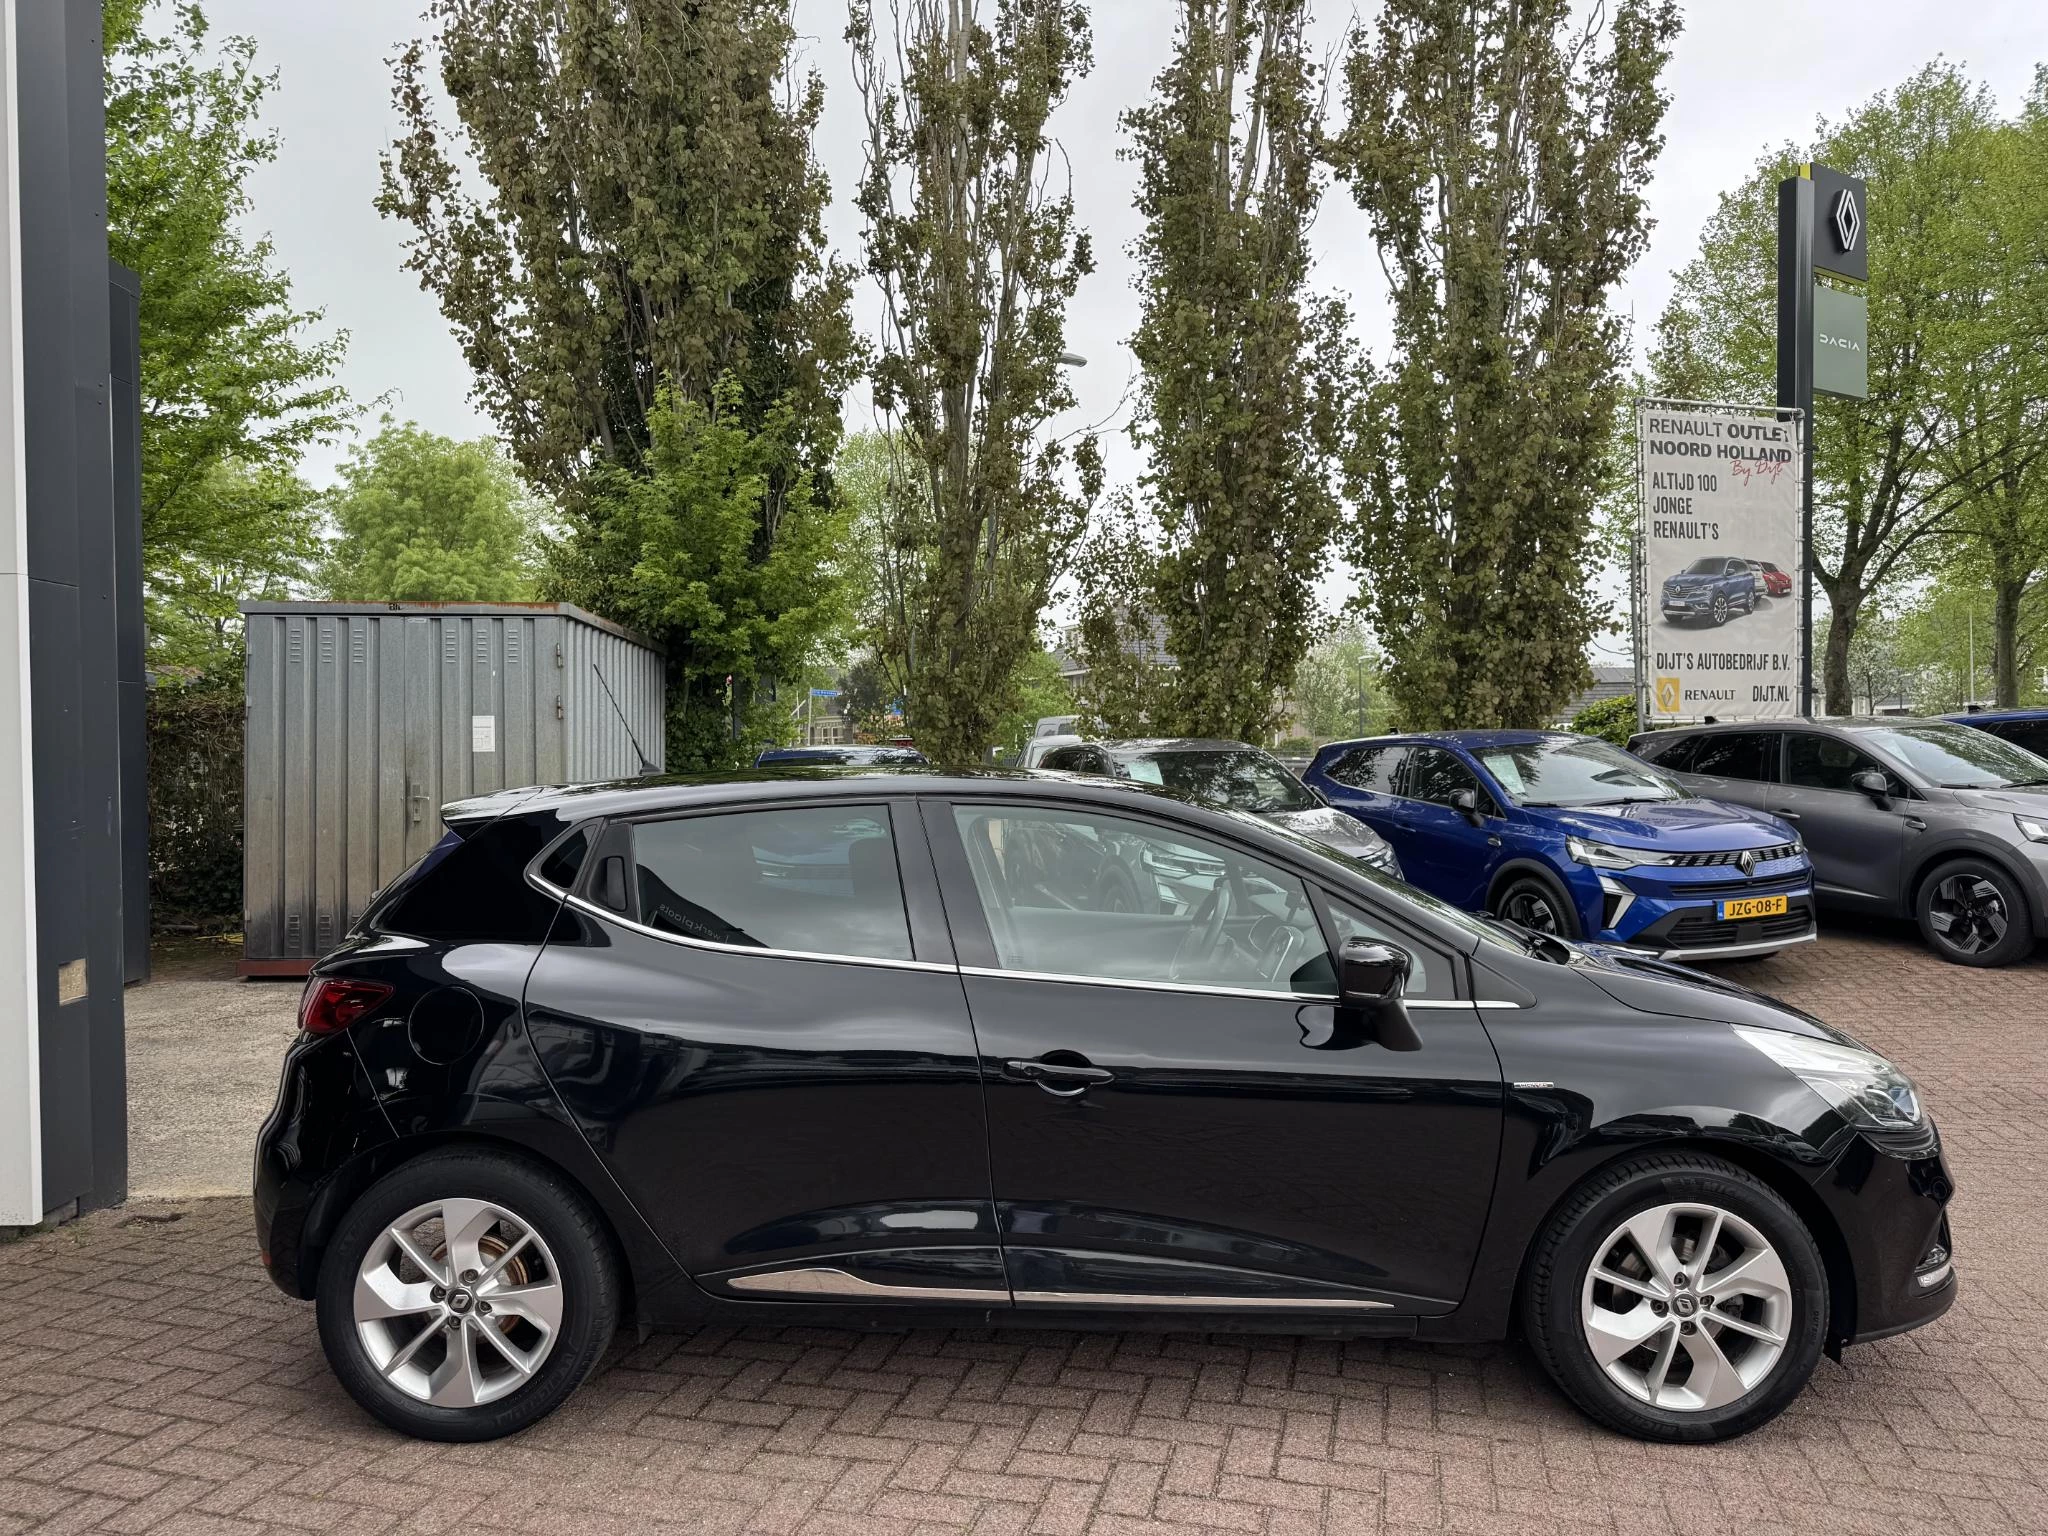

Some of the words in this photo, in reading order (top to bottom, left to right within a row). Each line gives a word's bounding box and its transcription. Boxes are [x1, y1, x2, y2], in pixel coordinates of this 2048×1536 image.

[1819, 333, 1860, 352] DACIA
[1650, 418, 1722, 438] RENAULT
[1650, 440, 1712, 457] NOORD
[1717, 444, 1792, 463] HOLLAND
[1653, 471, 1694, 491] ALTIJD
[1697, 474, 1717, 492] 100
[1730, 460, 1752, 487] By
[1653, 496, 1693, 515] JONGE
[1653, 520, 1719, 540] RENAULT'S
[1656, 652, 1694, 670] DIJT'S
[1697, 653, 1769, 670] AUTOBEDRIJF
[1772, 654, 1790, 671] B.V.
[1684, 689, 1737, 701] RENAULT
[1752, 685, 1790, 702] DIJT.NL
[1729, 898, 1783, 917] JZG-08-F
